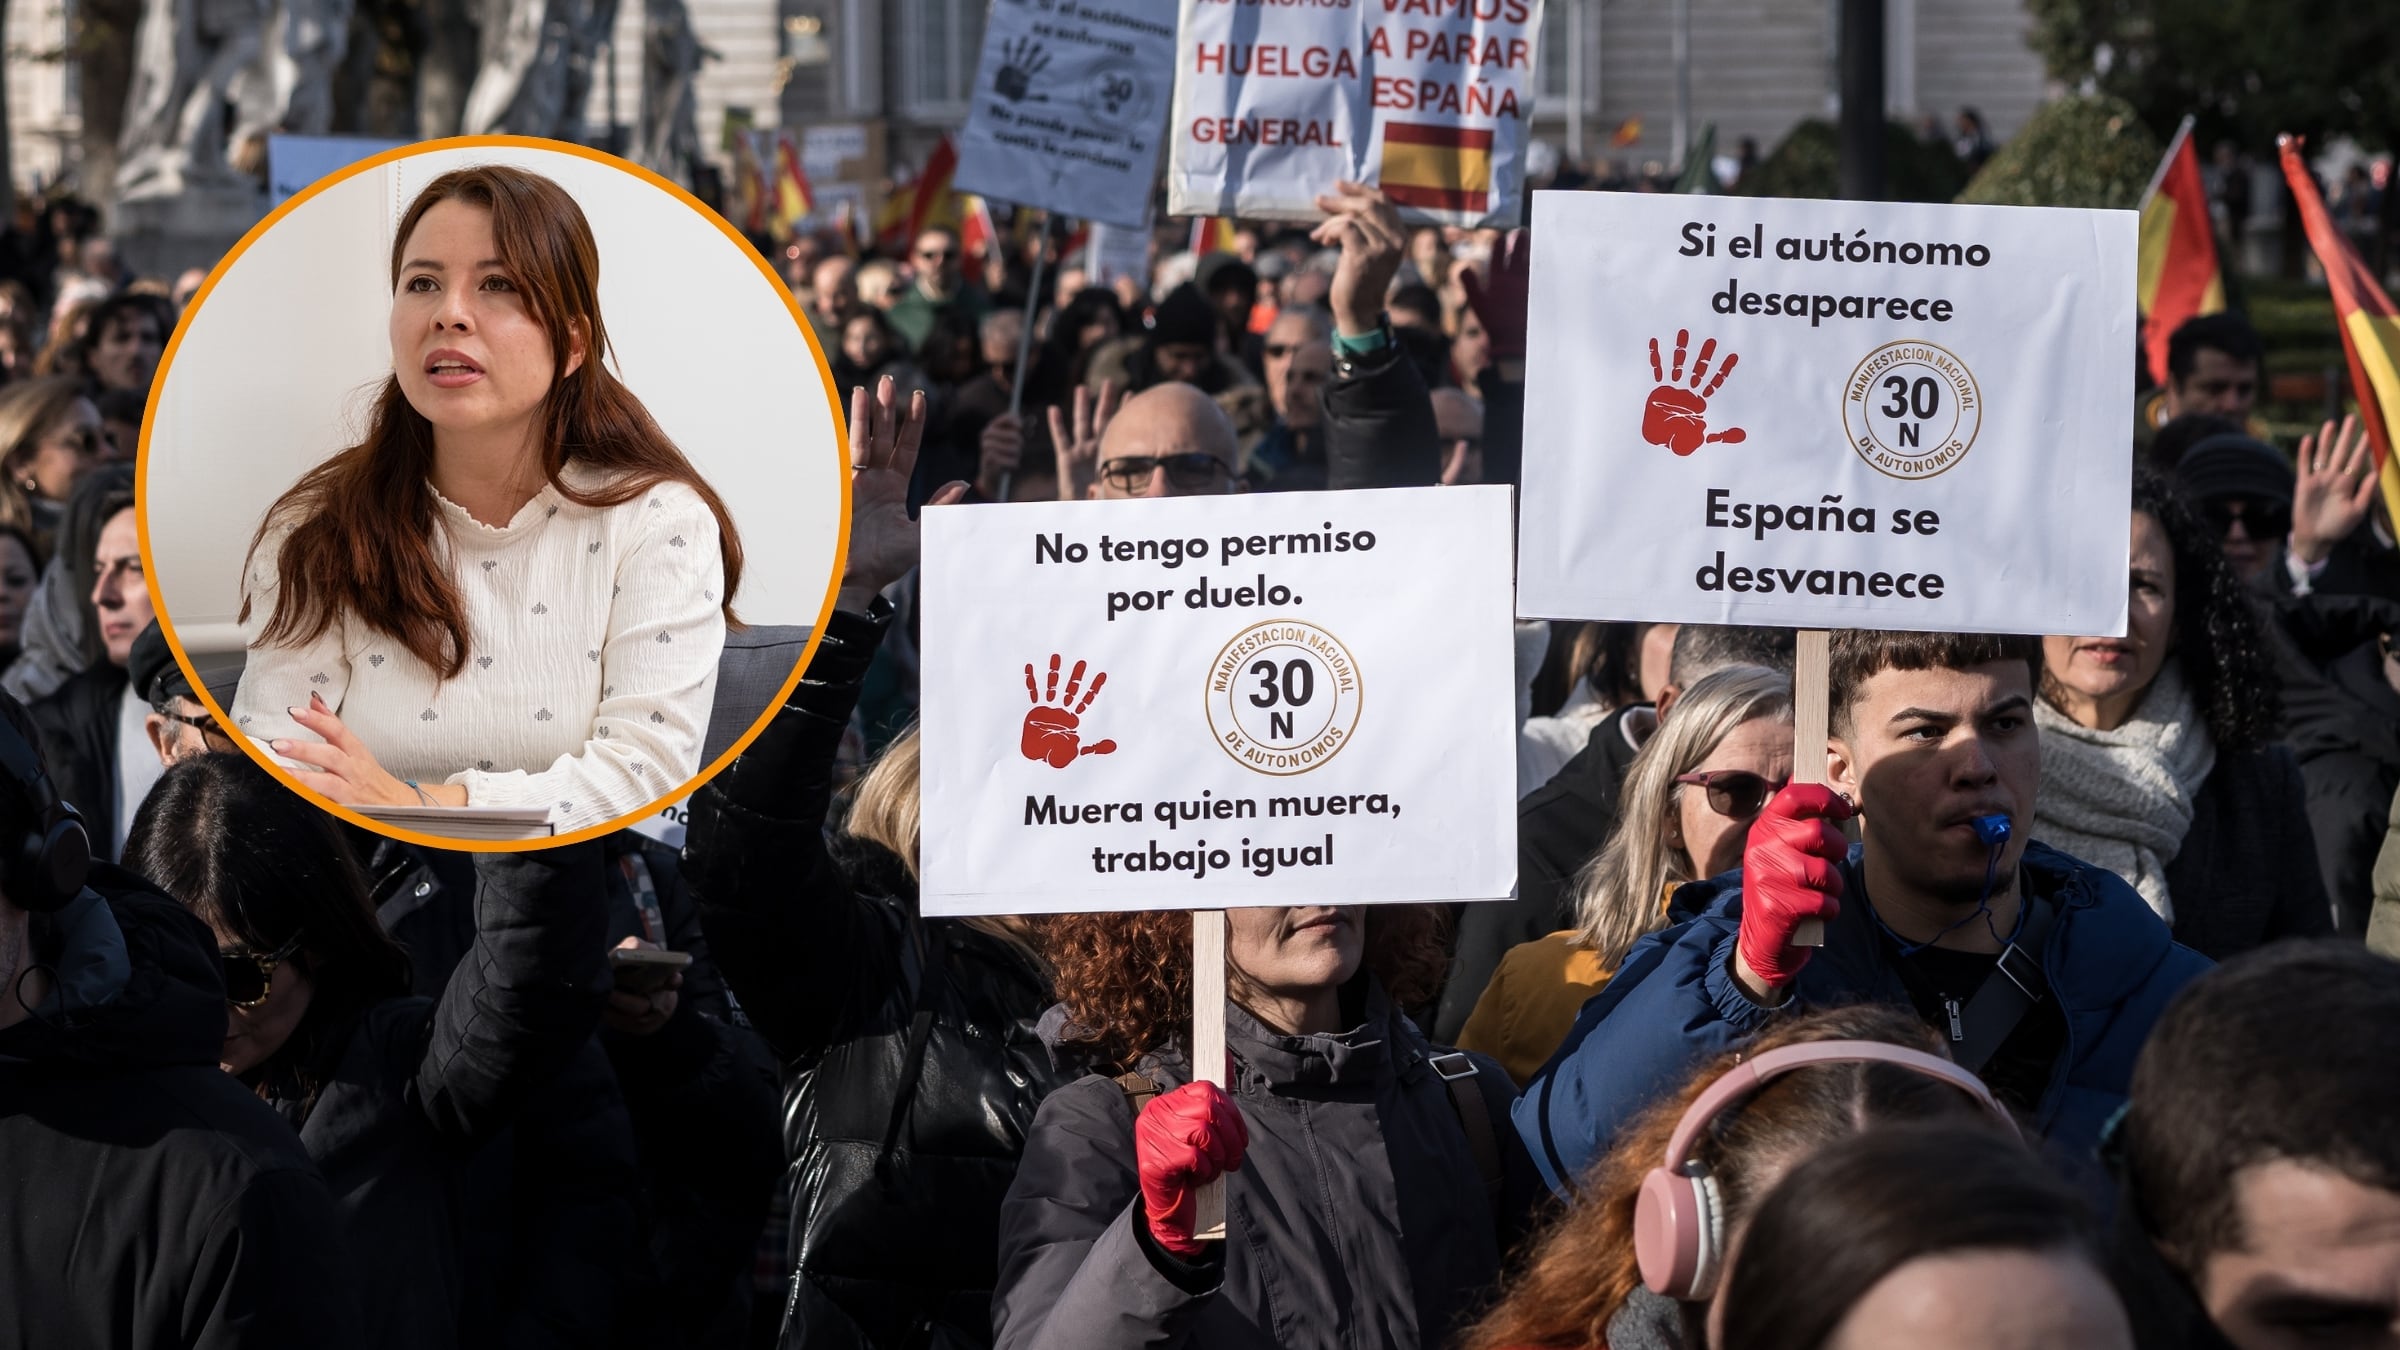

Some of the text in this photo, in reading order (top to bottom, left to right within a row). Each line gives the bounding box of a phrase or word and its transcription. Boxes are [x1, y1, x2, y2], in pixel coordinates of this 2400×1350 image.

[1196, 42, 1357, 79] HUELGA
[1366, 26, 1530, 71] A PARAR
[1371, 75, 1520, 119] ESPAÑA
[1191, 116, 1343, 147] GENERAL
[1679, 222, 1990, 266] Si el autónomo
[1712, 279, 1953, 327] desaparece
[1851, 347, 1974, 411] MANIFESTACION NACIONAL
[1882, 375, 1940, 420] 30
[1859, 436, 1963, 473] DE AUTONOMOS
[1899, 423, 1919, 447] N
[1706, 489, 1939, 540] España se
[1036, 522, 1375, 568] No tengo permiso
[1108, 574, 1302, 621] por duelo.
[1696, 551, 1944, 599] desvanece
[1214, 628, 1354, 694] MANIFESTACION NACIONAL
[1249, 658, 1314, 708] 30
[1225, 726, 1344, 768] DE AUTONOMOS
[1271, 712, 1293, 739] N
[1025, 790, 1401, 829] Muera quien muera,
[1092, 834, 1332, 879] trabajo igual
